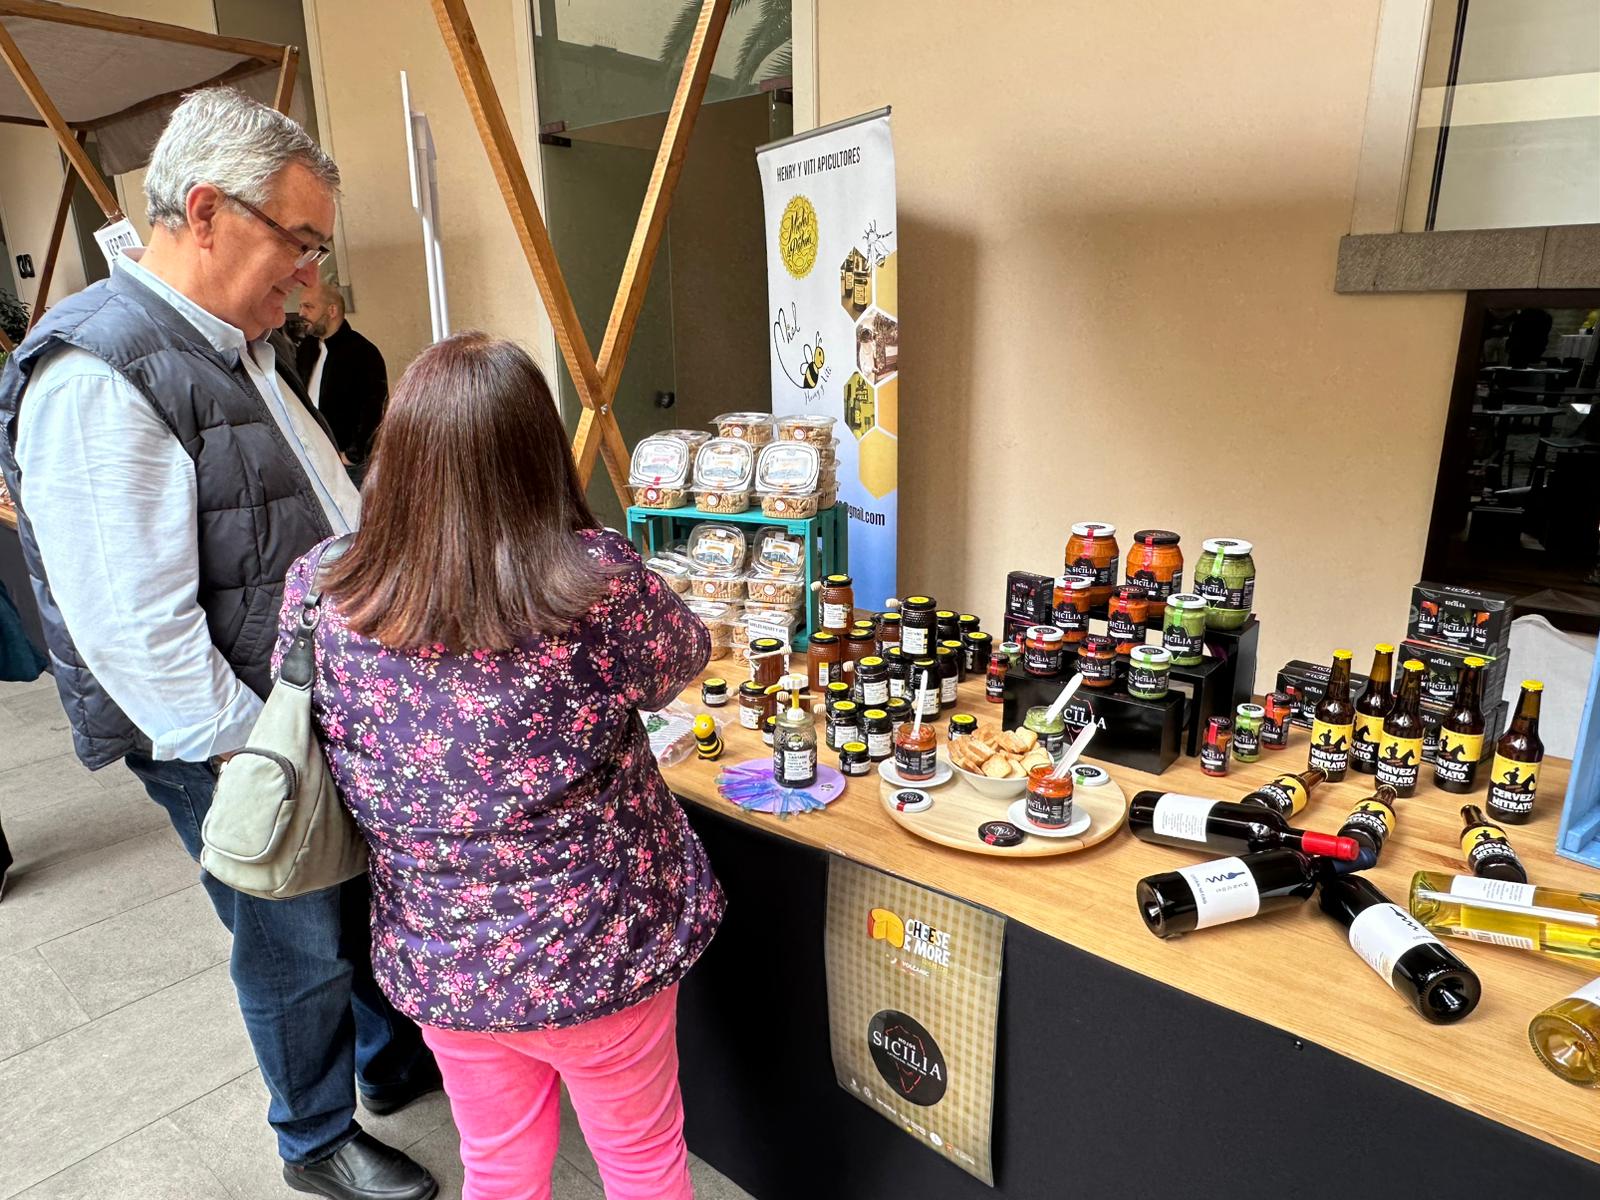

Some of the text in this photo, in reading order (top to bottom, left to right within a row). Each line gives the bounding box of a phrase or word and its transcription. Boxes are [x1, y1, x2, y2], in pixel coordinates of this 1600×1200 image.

[776, 146, 861, 183] HENRY Y VITI APICULTORES
[1072, 566, 1097, 575] SICILIA
[1133, 579, 1159, 588] SICILIA
[1201, 585, 1229, 595] SICILIA
[1055, 611, 1081, 620] SICILIA
[1109, 621, 1136, 631] SICILIA
[1029, 654, 1049, 662] SICILIA
[1081, 663, 1101, 671] SICILIA
[1063, 708, 1107, 730] CILIA
[1352, 740, 1374, 753] VEZA
[1311, 747, 1348, 761] CERVEZA
[1351, 748, 1371, 760] RATO
[1378, 760, 1416, 776] CERVEZA
[1492, 786, 1535, 801] CERVEZA
[905, 918, 951, 949] CHEESE
[903, 934, 951, 967] & MORE
[873, 1030, 942, 1081] SICILIA
